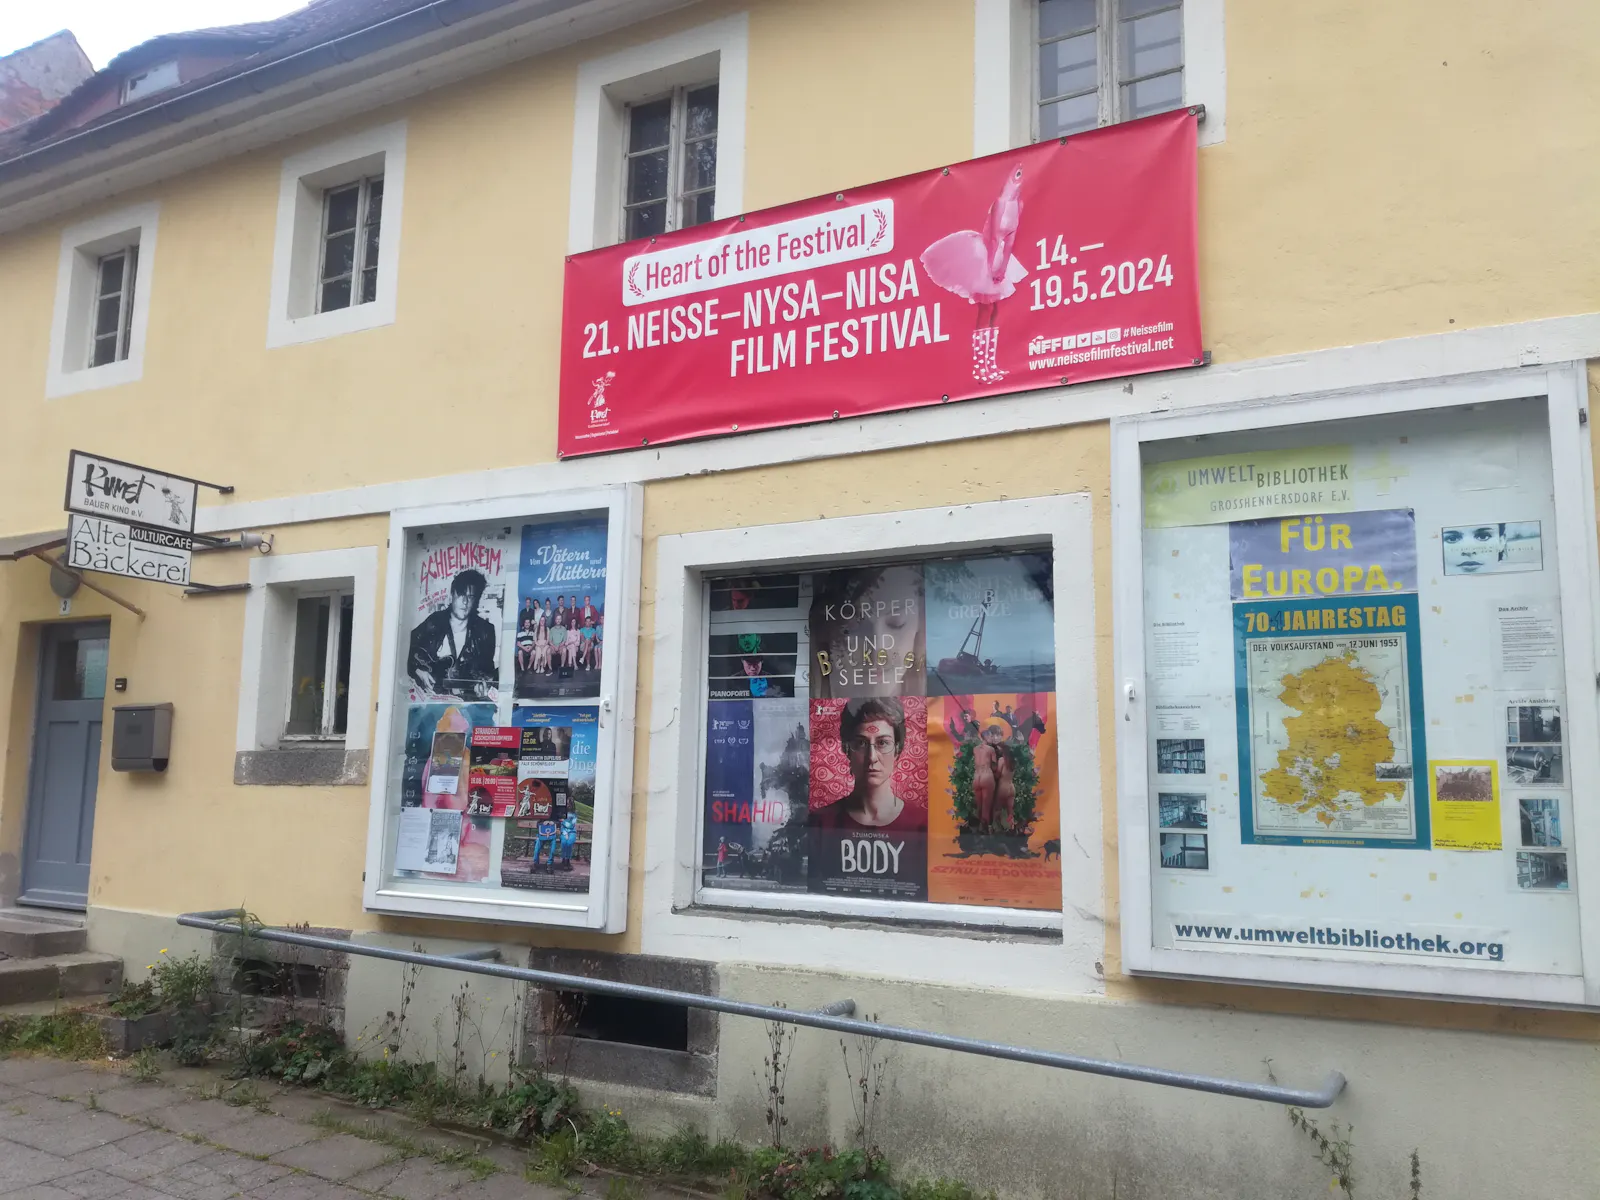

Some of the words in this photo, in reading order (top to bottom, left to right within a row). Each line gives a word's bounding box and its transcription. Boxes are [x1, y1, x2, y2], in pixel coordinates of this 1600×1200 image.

[646, 254, 702, 291] Heart
[708, 244, 731, 278] of
[735, 240, 770, 272] the
[777, 214, 866, 263] Festival
[1029, 254, 1173, 311] 19.5.2024
[582, 320, 619, 359] 21.
[627, 258, 920, 351] NEISSE–NYSA–NISA
[730, 329, 796, 377] FILM
[805, 302, 950, 365] FESTIVAL
[1029, 336, 1174, 370] www.neissefilmfestival.net
[84, 498, 110, 510] BAUER
[112, 504, 129, 515] KINO
[131, 509, 144, 518] e.V.
[1210, 491, 1324, 512] GROSSHENNERSDORF
[1331, 490, 1351, 502] E.V.
[74, 518, 126, 547] Alte
[130, 527, 192, 550] KULTURCAFÉ
[1280, 516, 1353, 553] FÜR
[71, 541, 188, 582] Bäckerei
[537, 544, 590, 565] Vätern
[420, 542, 502, 595] SCHLEIMKEIM
[537, 562, 607, 585] Müttern
[1242, 563, 1403, 598] EUROPA.
[825, 599, 917, 621] KÖRPER
[948, 602, 1013, 620] GRENZE
[1283, 605, 1407, 631] JAHRESTAG
[1244, 612, 1276, 633] 70.
[847, 634, 895, 652] UND
[1253, 643, 1268, 652] DER
[1271, 641, 1334, 651] VOLKSAUFSTAND
[1358, 639, 1378, 649] JUNI
[1380, 638, 1399, 648] 1953
[839, 666, 904, 686] SEELE
[572, 740, 591, 755] die
[712, 800, 784, 823] SHAHID
[840, 839, 905, 874] BODY
[1002, 869, 1020, 877] DO
[1175, 923, 1504, 961] www.umweltbibliothek.org
